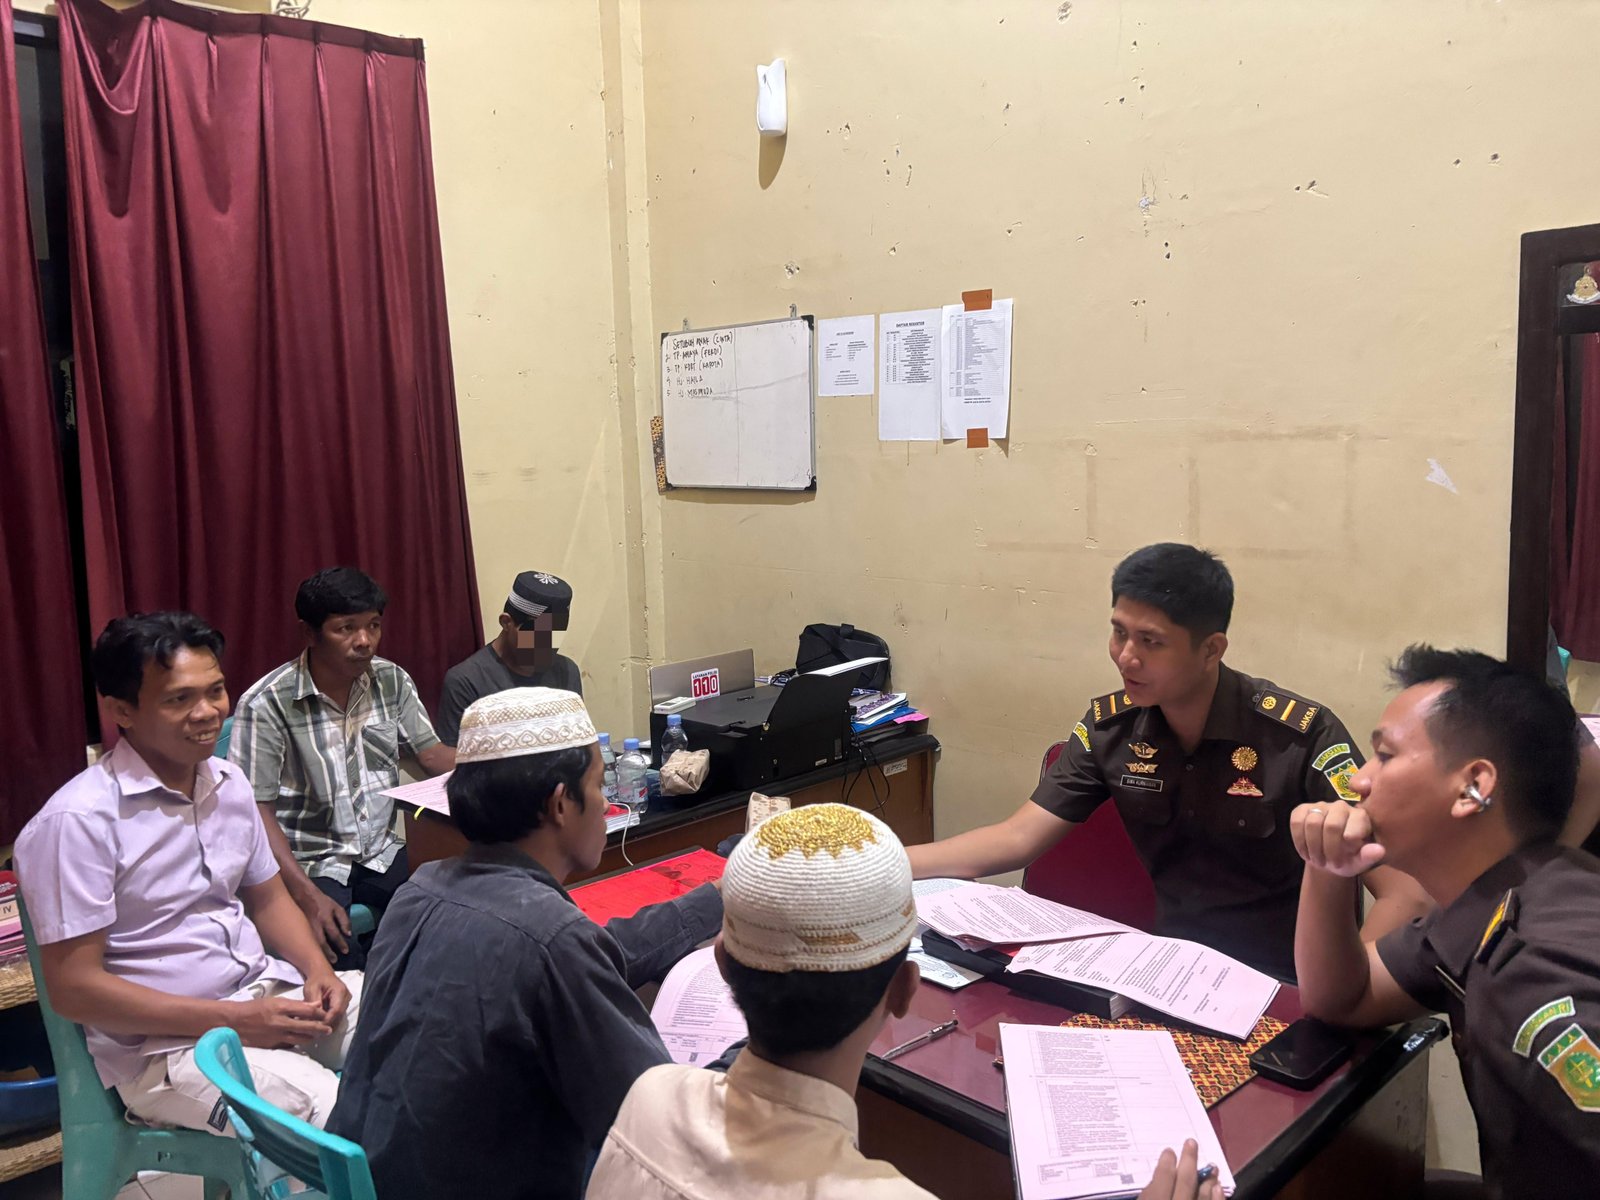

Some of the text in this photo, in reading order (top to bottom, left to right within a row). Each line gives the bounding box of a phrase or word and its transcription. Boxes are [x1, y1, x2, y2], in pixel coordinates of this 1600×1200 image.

[694, 677, 717, 695] 110
[1093, 700, 1102, 721] JAKSA
[1299, 707, 1317, 730] JAKSA
